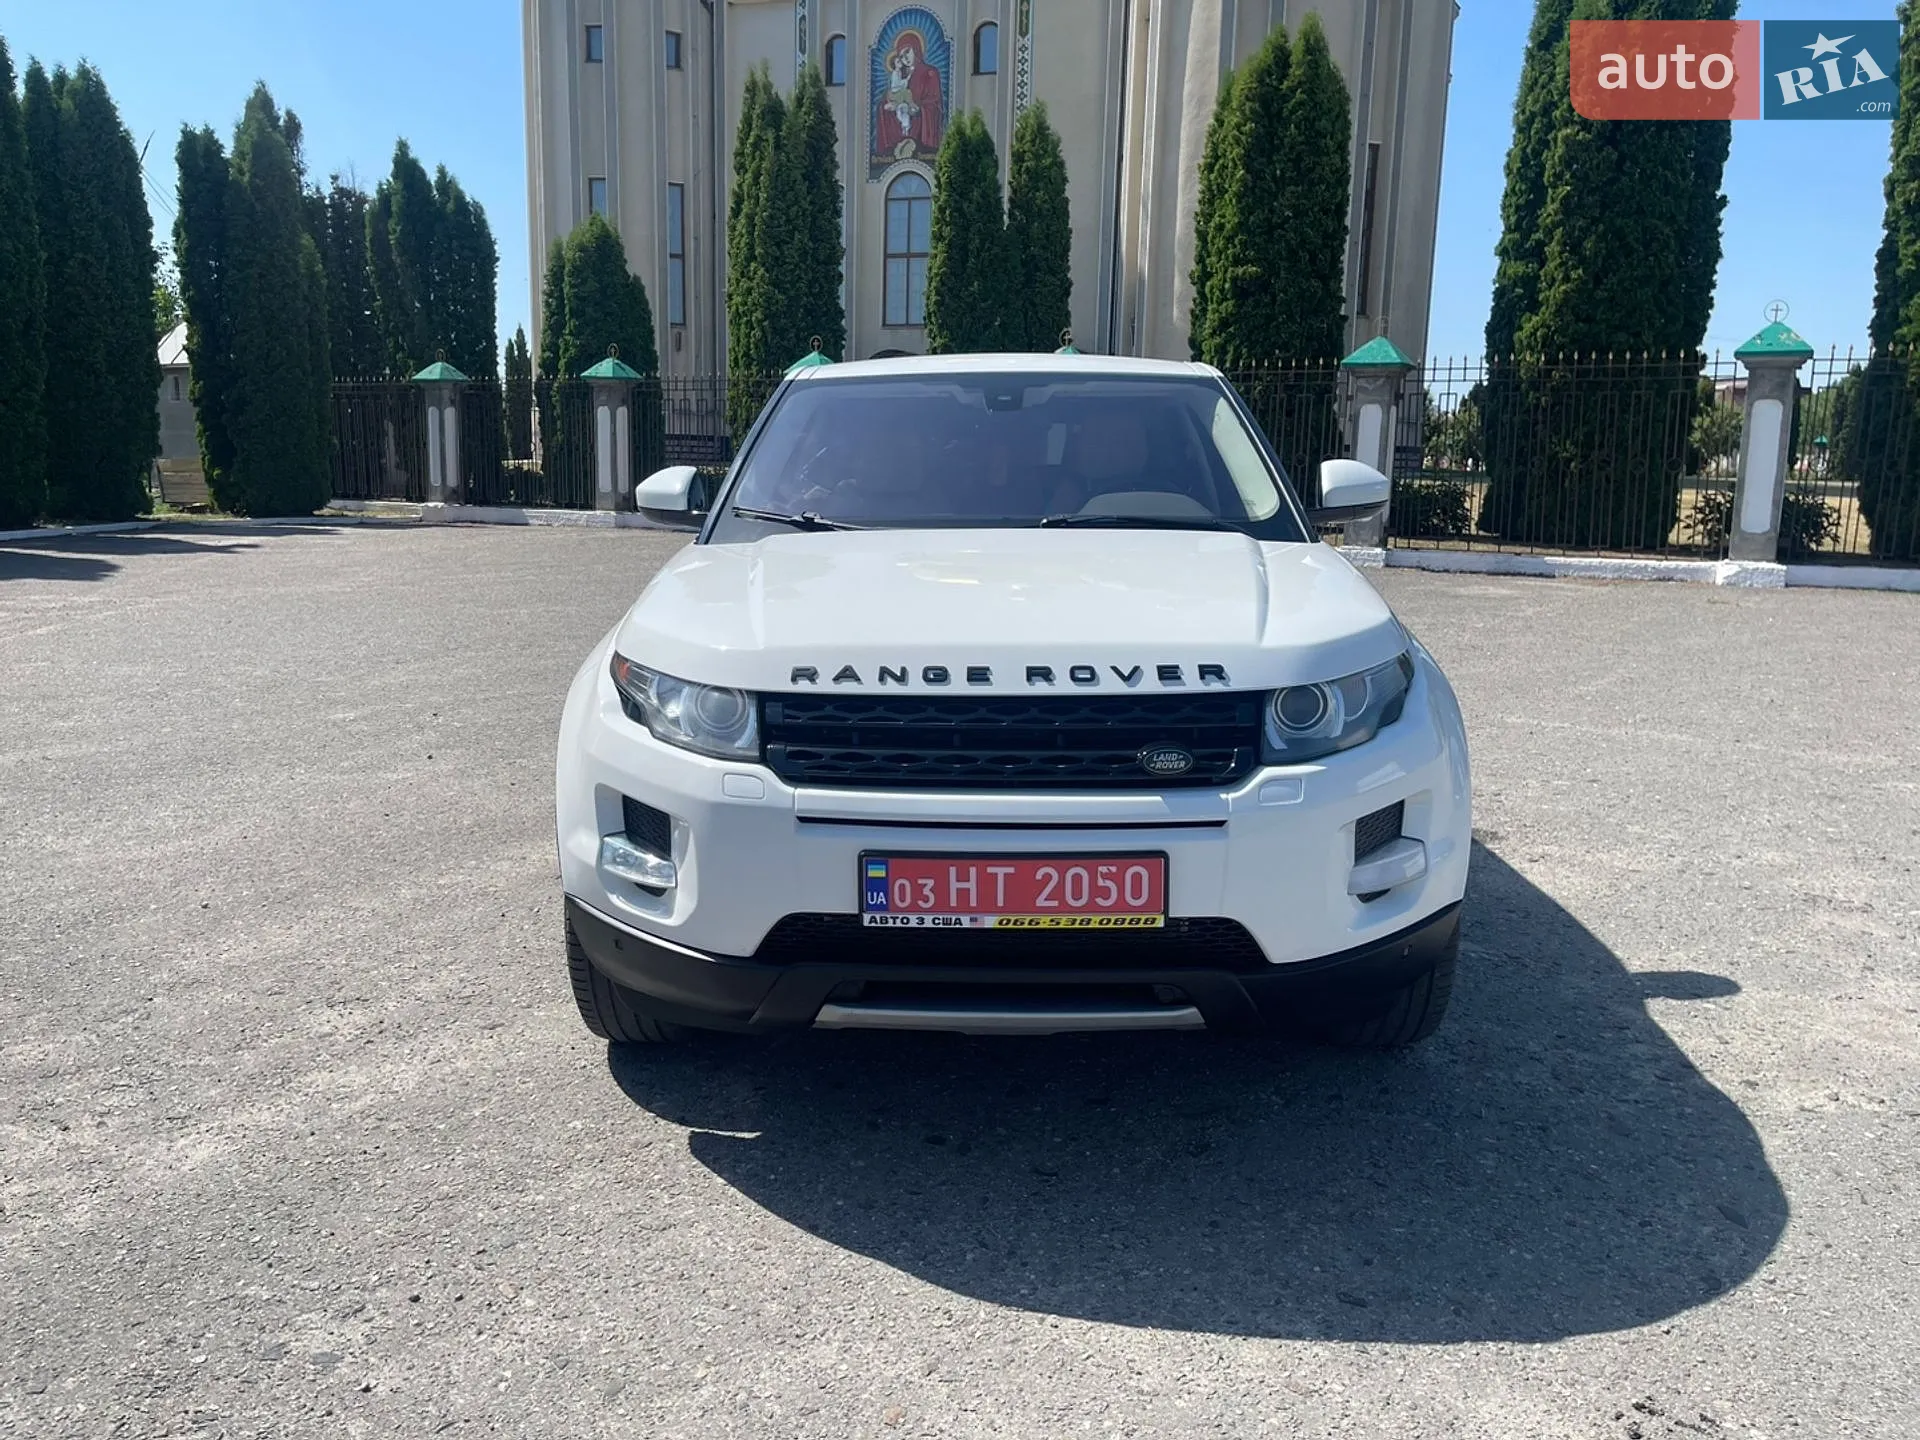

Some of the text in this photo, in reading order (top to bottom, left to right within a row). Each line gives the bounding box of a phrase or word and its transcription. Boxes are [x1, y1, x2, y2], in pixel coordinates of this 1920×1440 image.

[791, 664, 1226, 683] RANGE ROVER
[1154, 753, 1178, 761] LAND
[1155, 761, 1185, 769] ROVER
[893, 878, 935, 908] 03
[1035, 865, 1149, 907] 2050
[867, 892, 886, 905] UA
[869, 916, 910, 925] АВТО
[931, 917, 963, 926] США
